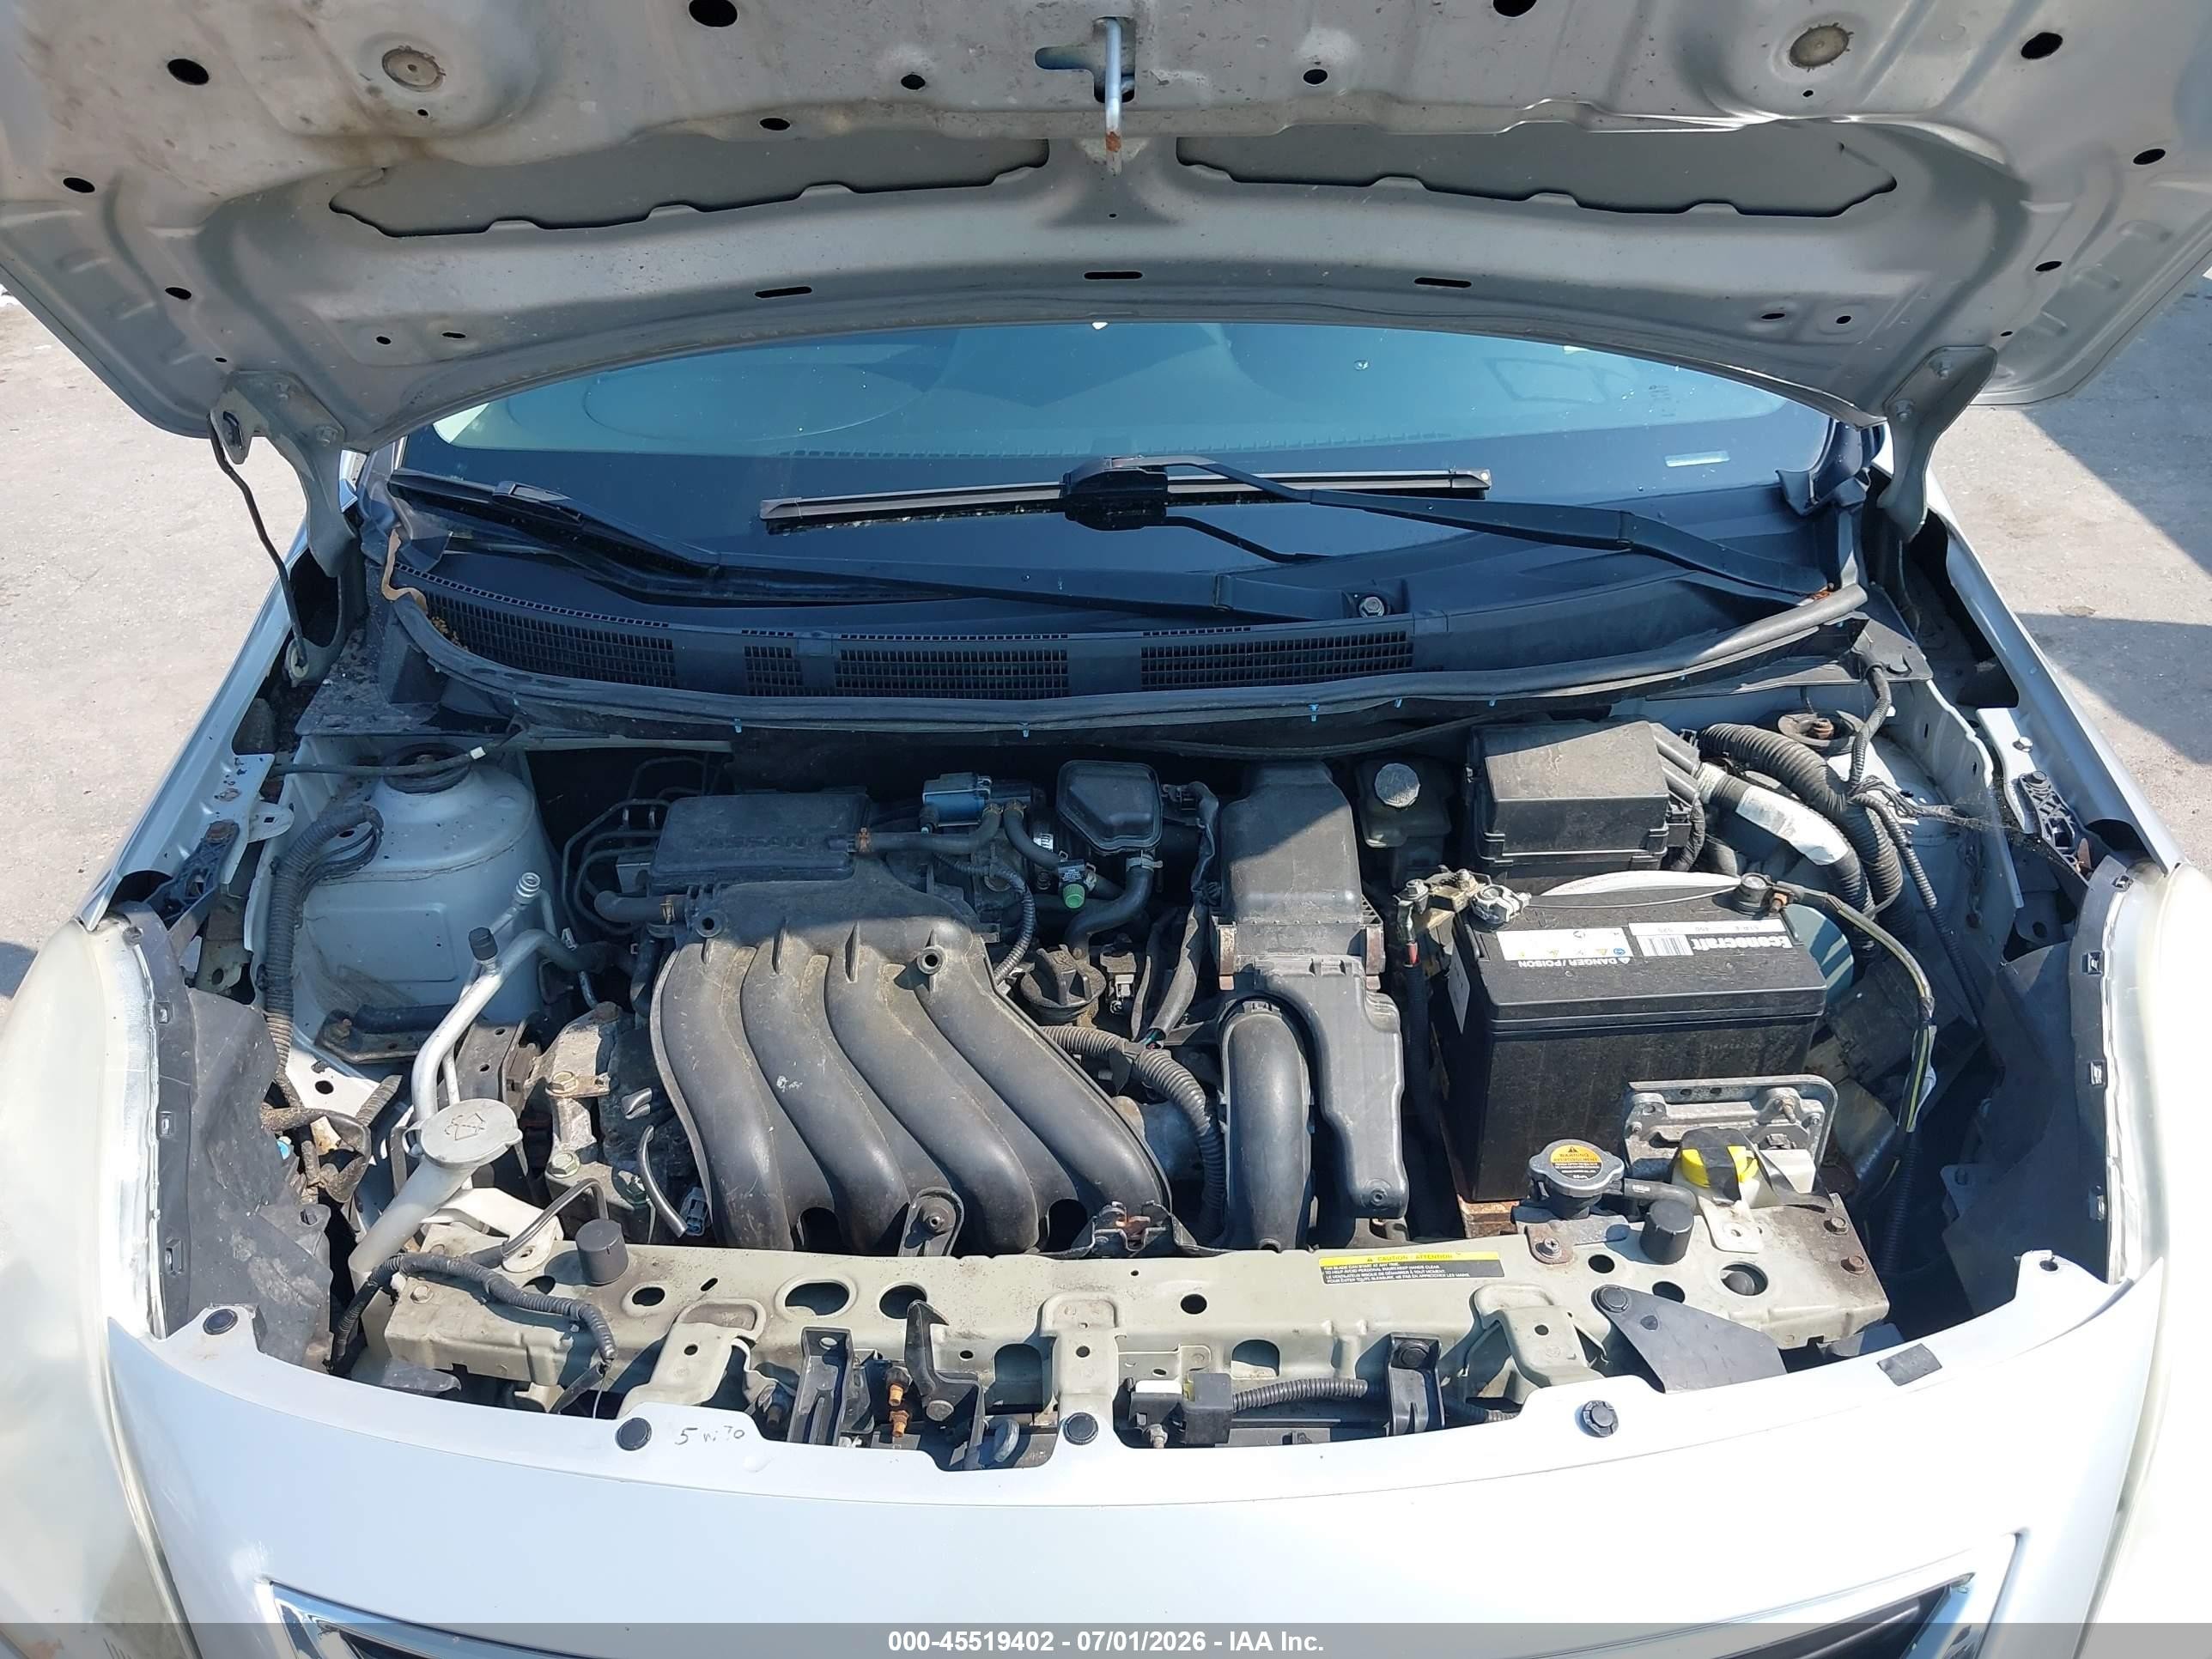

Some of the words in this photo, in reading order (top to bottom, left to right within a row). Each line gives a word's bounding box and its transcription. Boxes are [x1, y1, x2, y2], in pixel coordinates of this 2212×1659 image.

[1691, 935, 1792, 951] Econocraft
[1518, 959, 1561, 968] POISON
[1569, 957, 1618, 966] DANGER
